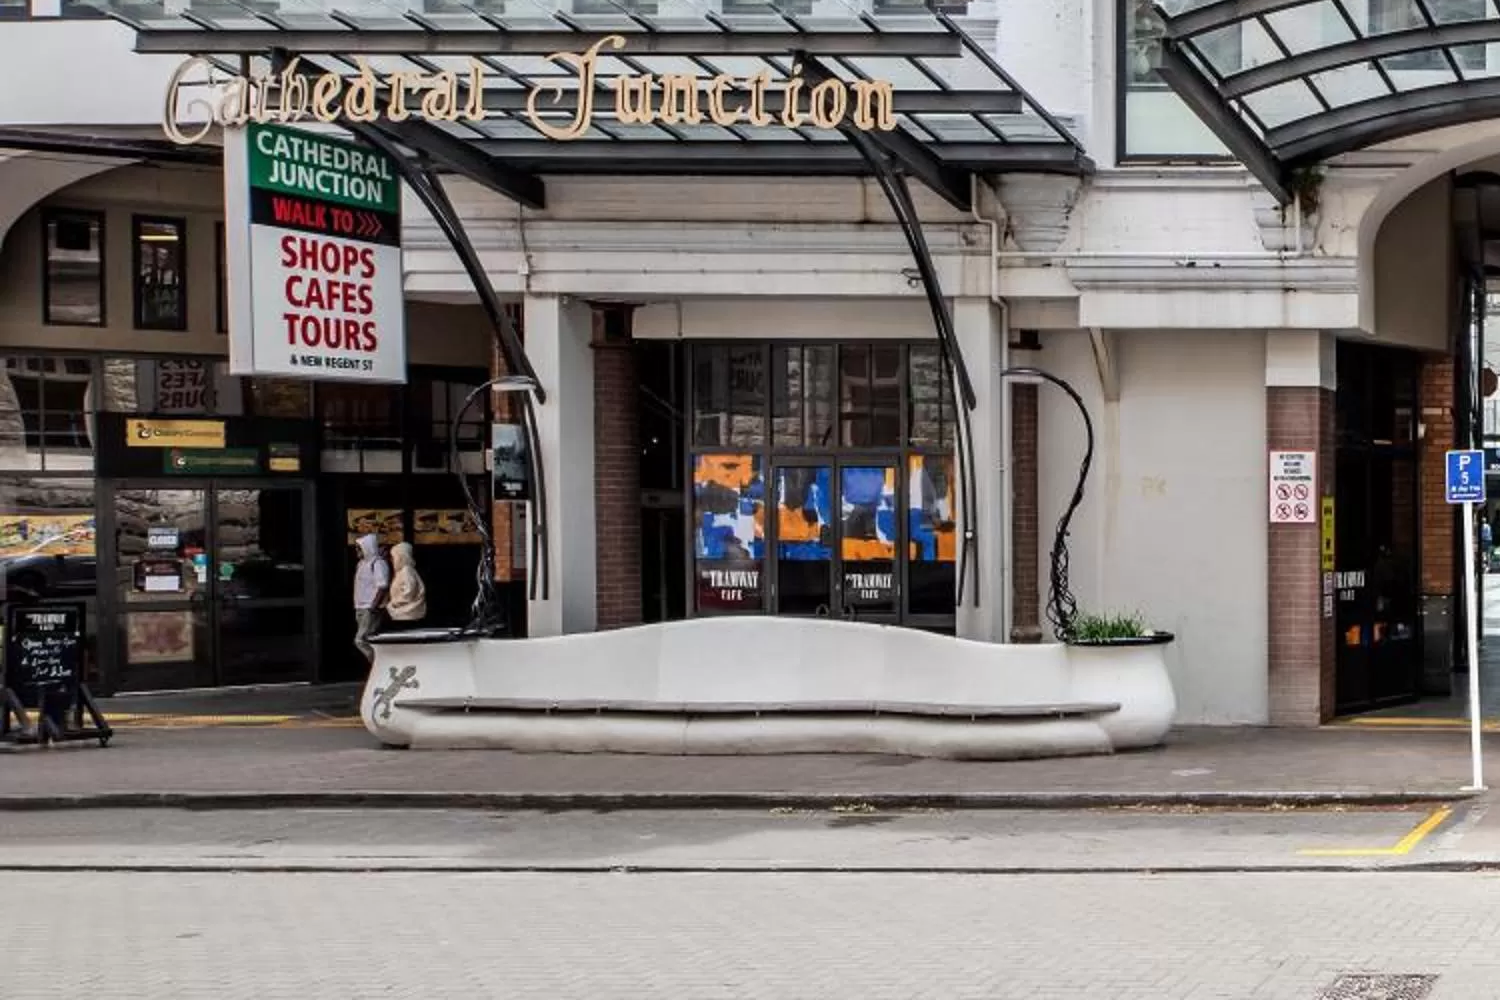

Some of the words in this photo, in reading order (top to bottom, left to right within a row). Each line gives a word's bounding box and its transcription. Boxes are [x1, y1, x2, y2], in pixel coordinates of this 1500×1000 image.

[163, 54, 488, 144] Cathedral
[526, 34, 897, 141] Junction
[256, 130, 393, 180] CATHEDRAL
[268, 160, 383, 203] JUNCTION
[273, 197, 328, 229] WALK
[331, 209, 354, 232] TO
[281, 235, 376, 279] SHOPS
[285, 275, 374, 315] CAFES
[283, 313, 378, 352] TOURS
[301, 355, 324, 367] NEW
[325, 358, 359, 371] REGENT
[363, 361, 373, 371] ST
[1459, 455, 1471, 471] P
[1461, 471, 1469, 484] 5
[710, 570, 759, 589] TRAMWAY
